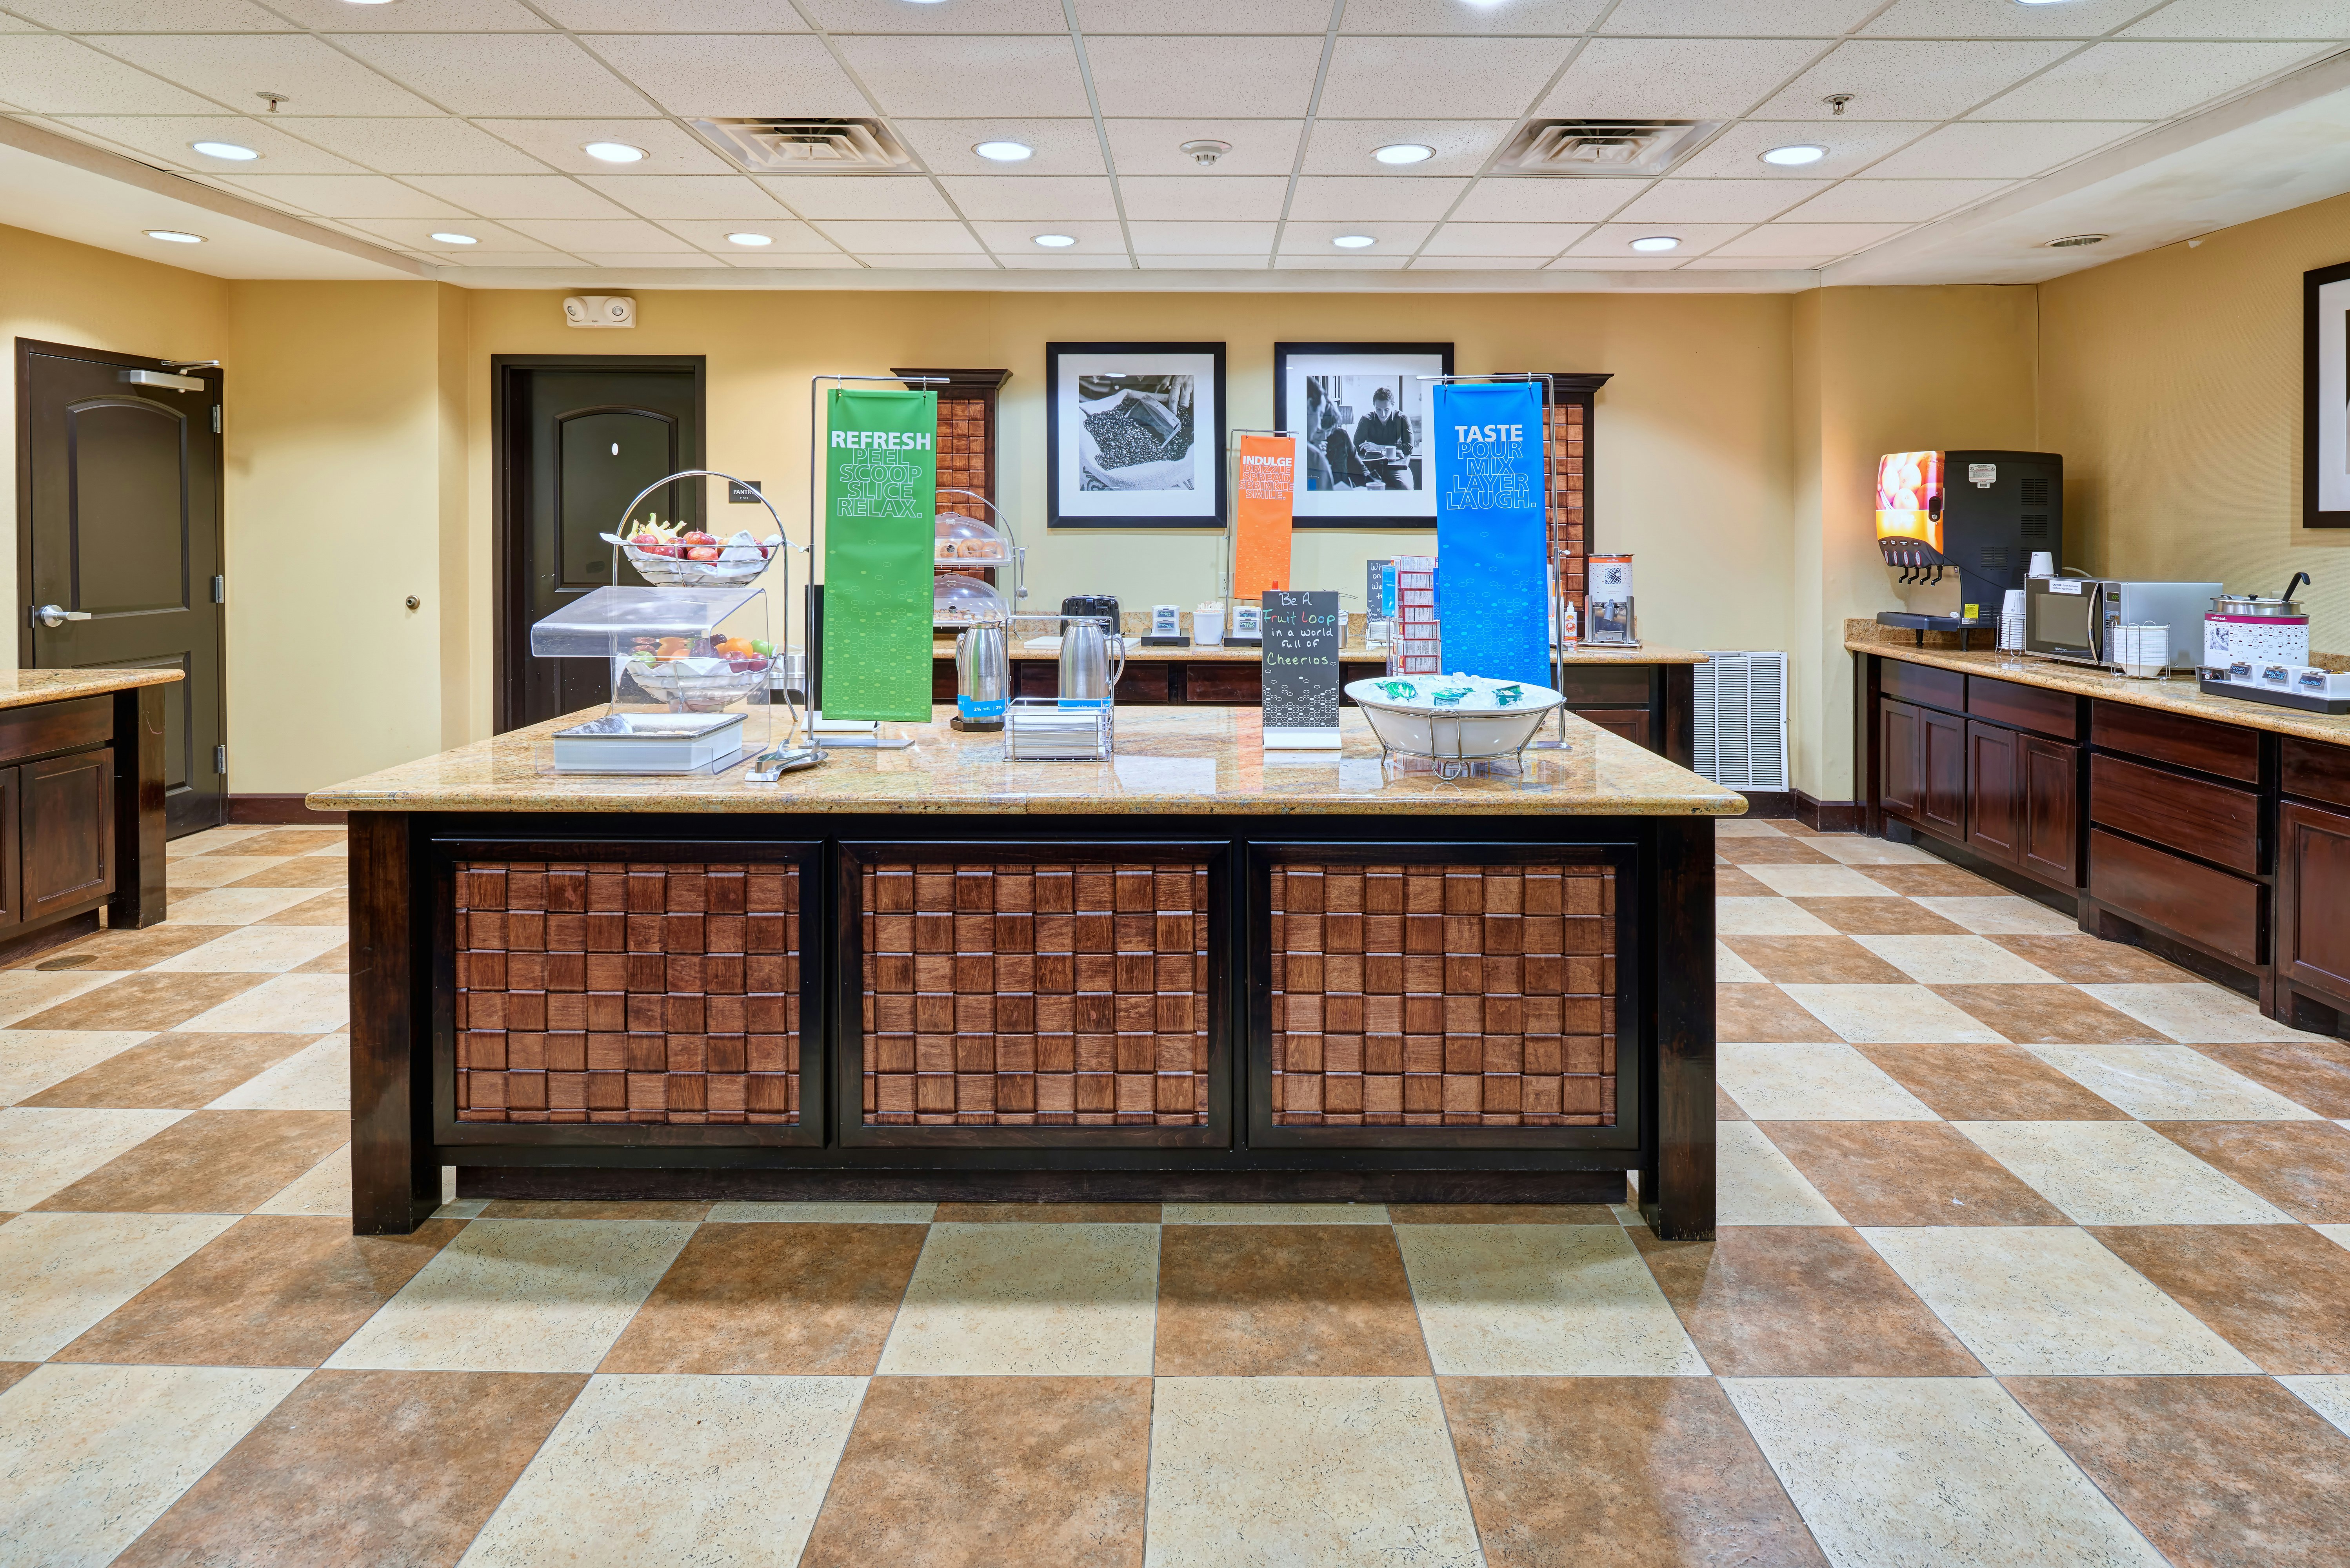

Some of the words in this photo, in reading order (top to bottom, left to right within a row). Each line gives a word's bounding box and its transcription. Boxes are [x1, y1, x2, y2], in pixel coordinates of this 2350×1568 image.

[831, 430, 931, 450] REFRESH
[1455, 424, 1523, 442] TASTE
[853, 448, 910, 466] PEEL
[1457, 440, 1523, 459] POUR
[1243, 456, 1292, 466] INDULGE
[1243, 464, 1291, 475] DRIZZLE
[1467, 457, 1515, 476] MIX
[840, 464, 922, 483] SCOOP
[1243, 472, 1291, 483] SPREAD
[848, 481, 913, 500] SLICE
[1239, 481, 1294, 492] SPRINKLE
[1453, 474, 1530, 492] LAYER
[1245, 489, 1286, 500] SMILE.
[1446, 490, 1536, 510] LAUGH.
[837, 498, 923, 518] RELAX.
[1278, 592, 1299, 606] Be
[1302, 592, 1312, 606] A
[1263, 608, 1297, 625] Fruit
[1301, 611, 1336, 626] Loop
[1272, 628, 1283, 637] in
[1300, 627, 1334, 637] world
[1267, 652, 1329, 666] Cheerios
